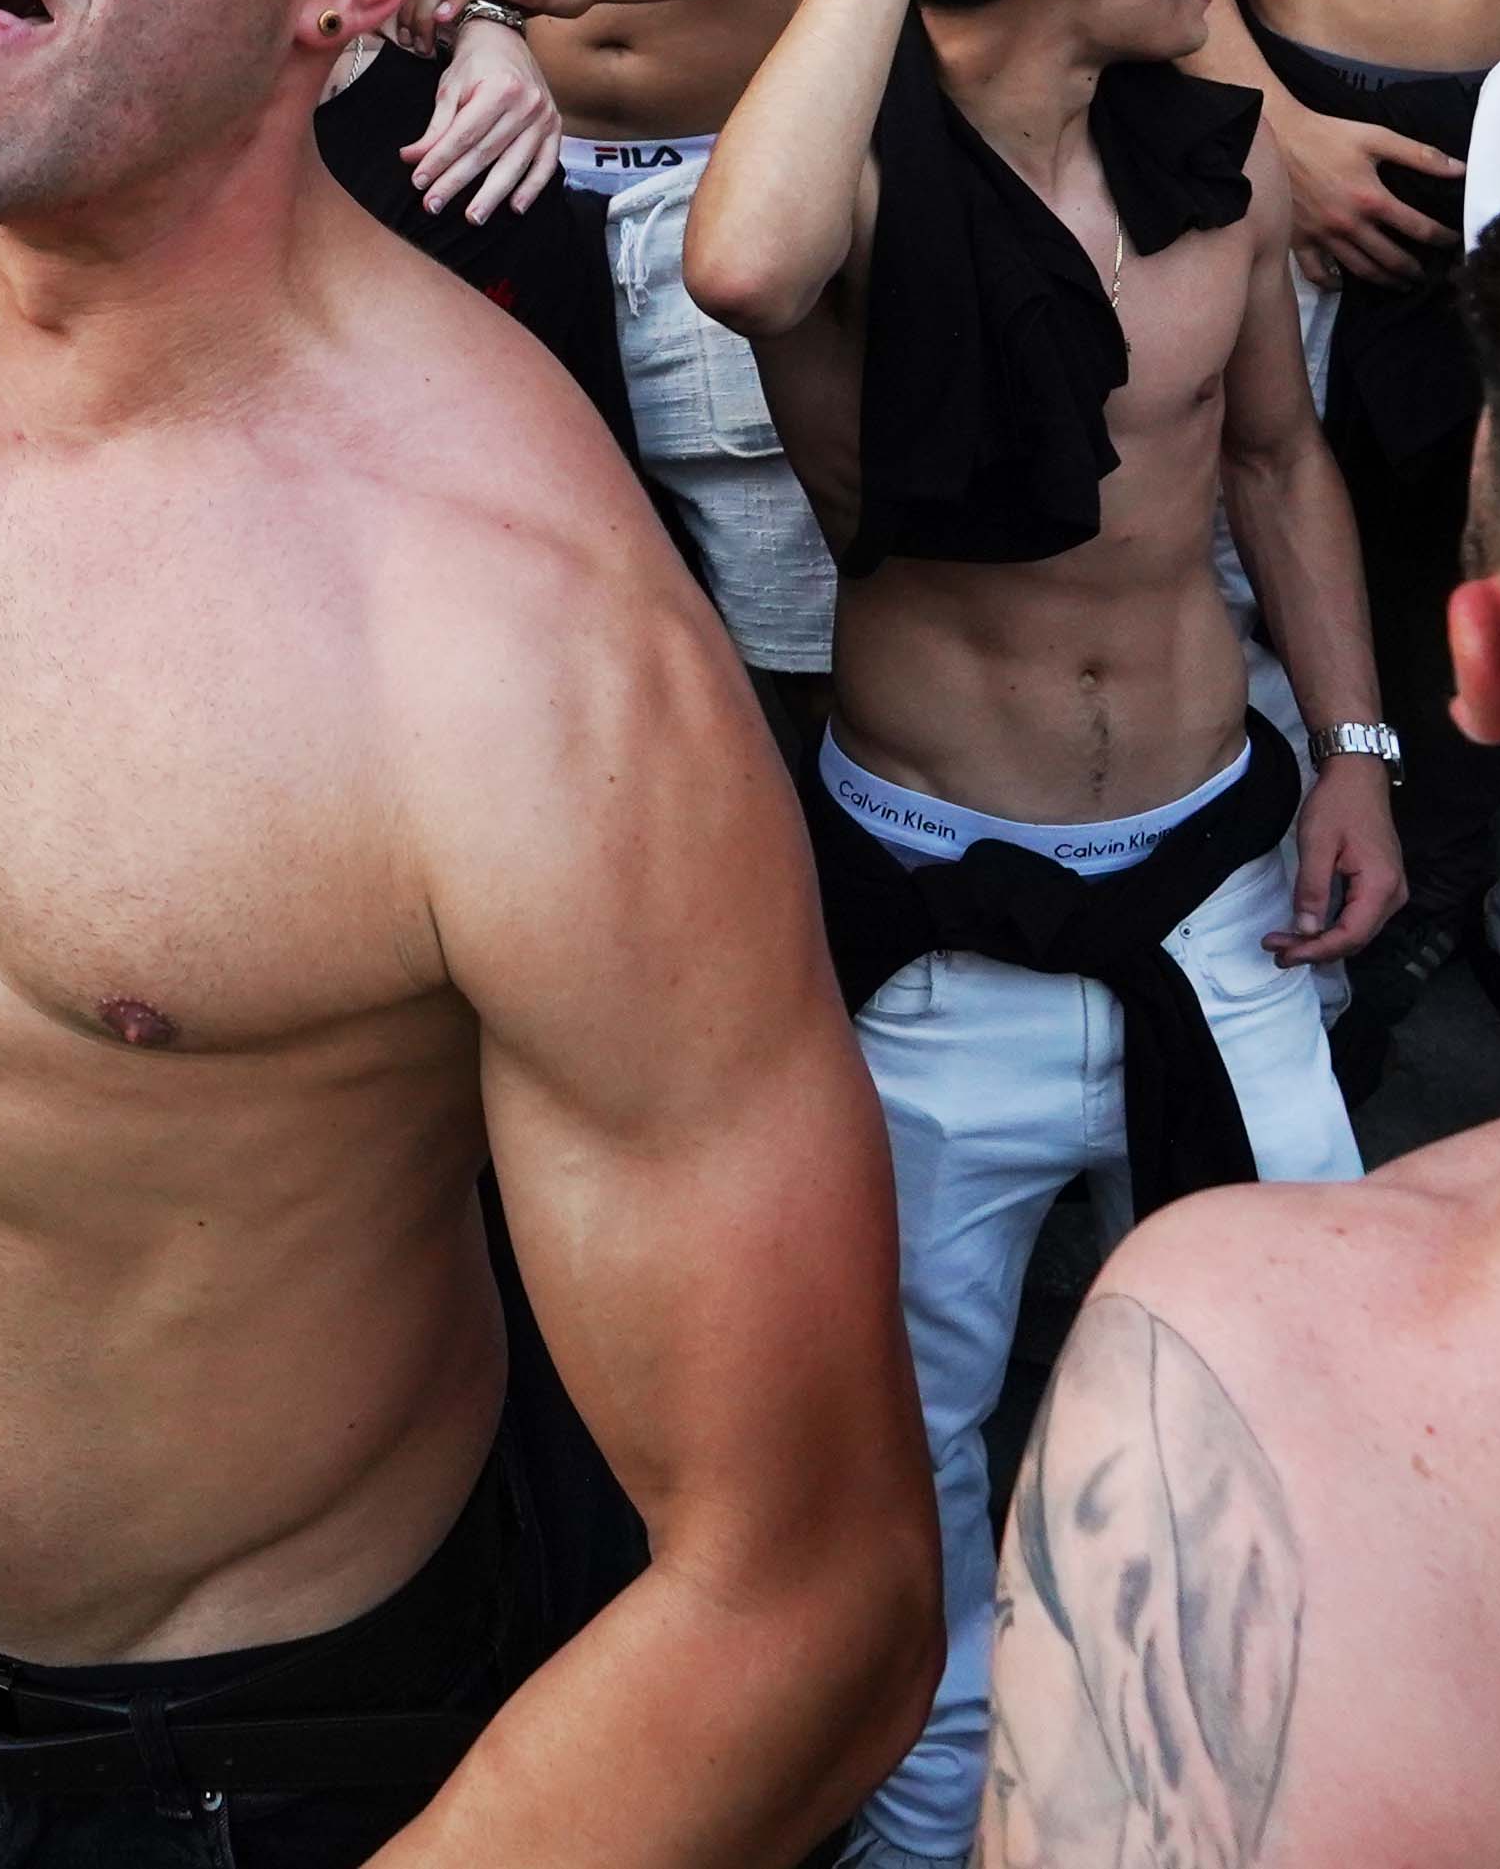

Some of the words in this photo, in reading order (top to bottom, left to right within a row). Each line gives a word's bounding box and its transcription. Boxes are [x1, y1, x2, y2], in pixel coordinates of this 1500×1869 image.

[594, 145, 684, 169] FILA
[838, 780, 900, 825] Calvin
[902, 809, 957, 842] Klein
[1054, 838, 1125, 860] Calvin
[1128, 827, 1172, 853] Klein
